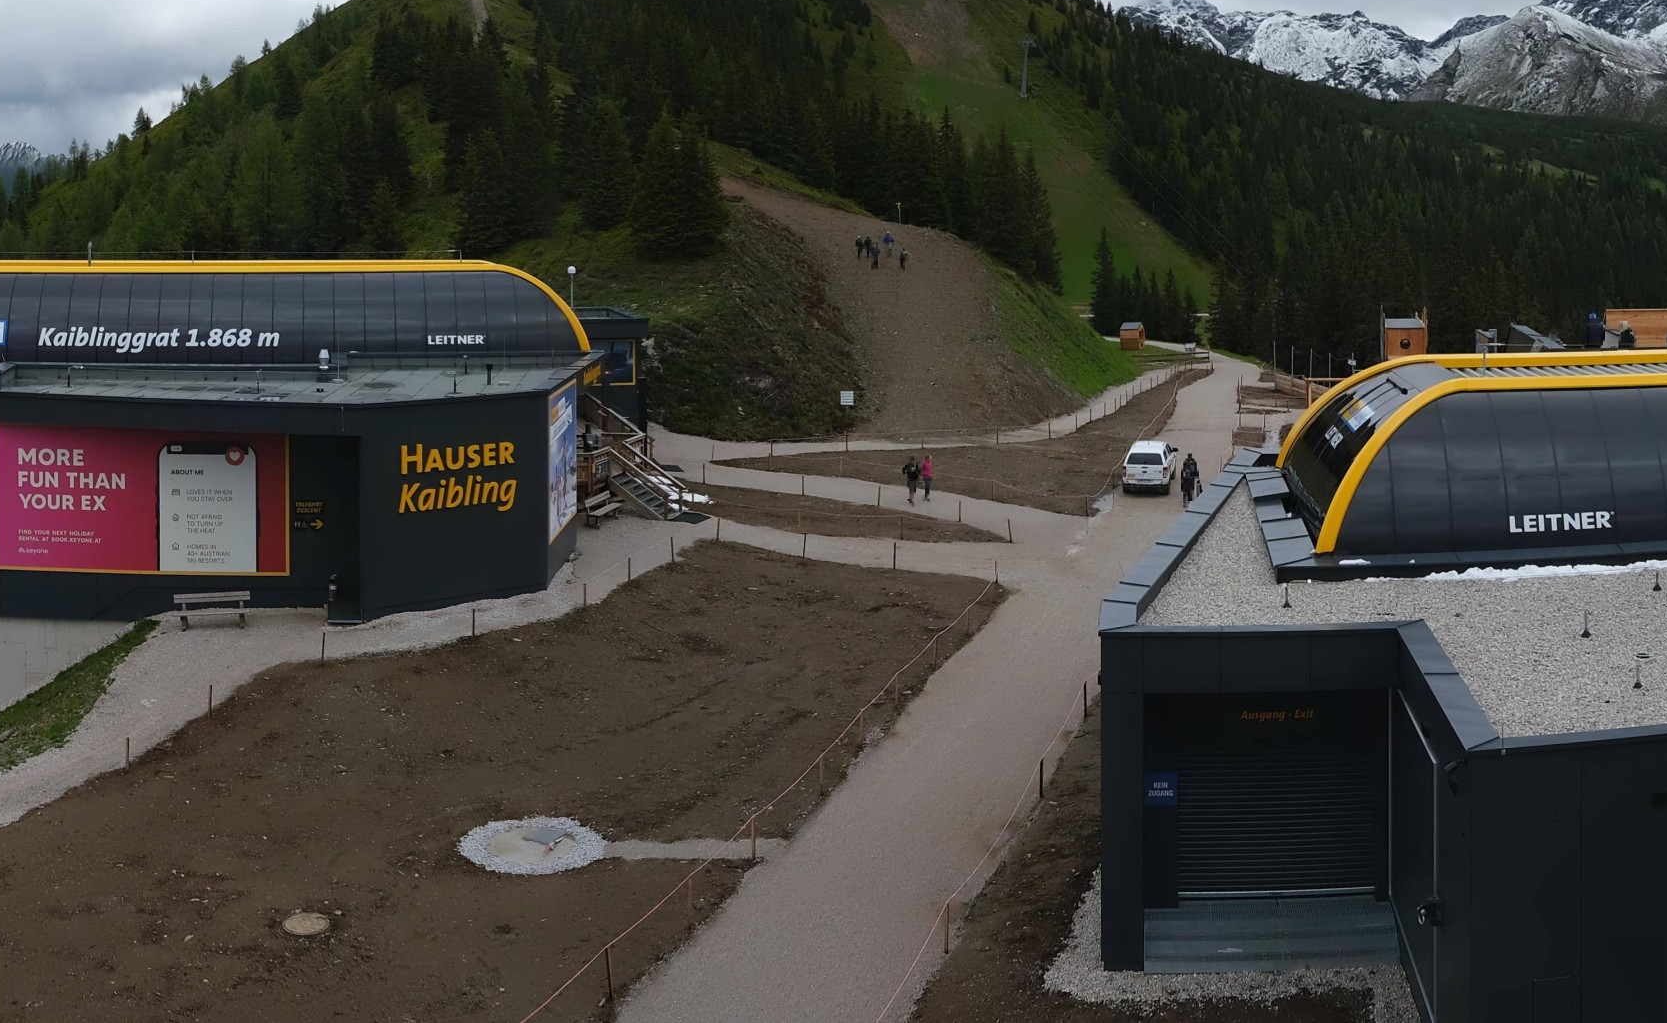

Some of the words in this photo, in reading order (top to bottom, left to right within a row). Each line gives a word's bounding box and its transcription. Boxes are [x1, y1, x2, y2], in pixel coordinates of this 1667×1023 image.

[38, 327, 179, 353] Kaiblinggrat
[185, 328, 252, 347] 1.868
[257, 332, 280, 347] m
[427, 334, 485, 345] LEITNER
[18, 448, 84, 466] MORE
[400, 441, 515, 474] HAUSER
[18, 470, 59, 488] FUN
[66, 472, 126, 490] THAN
[19, 494, 74, 510] YOUR
[82, 495, 106, 511] EX
[398, 476, 517, 514] Kaibling
[1509, 511, 1613, 533] LEITNER
[1240, 710, 1286, 722] Ausgang
[1294, 708, 1314, 719] Exit
